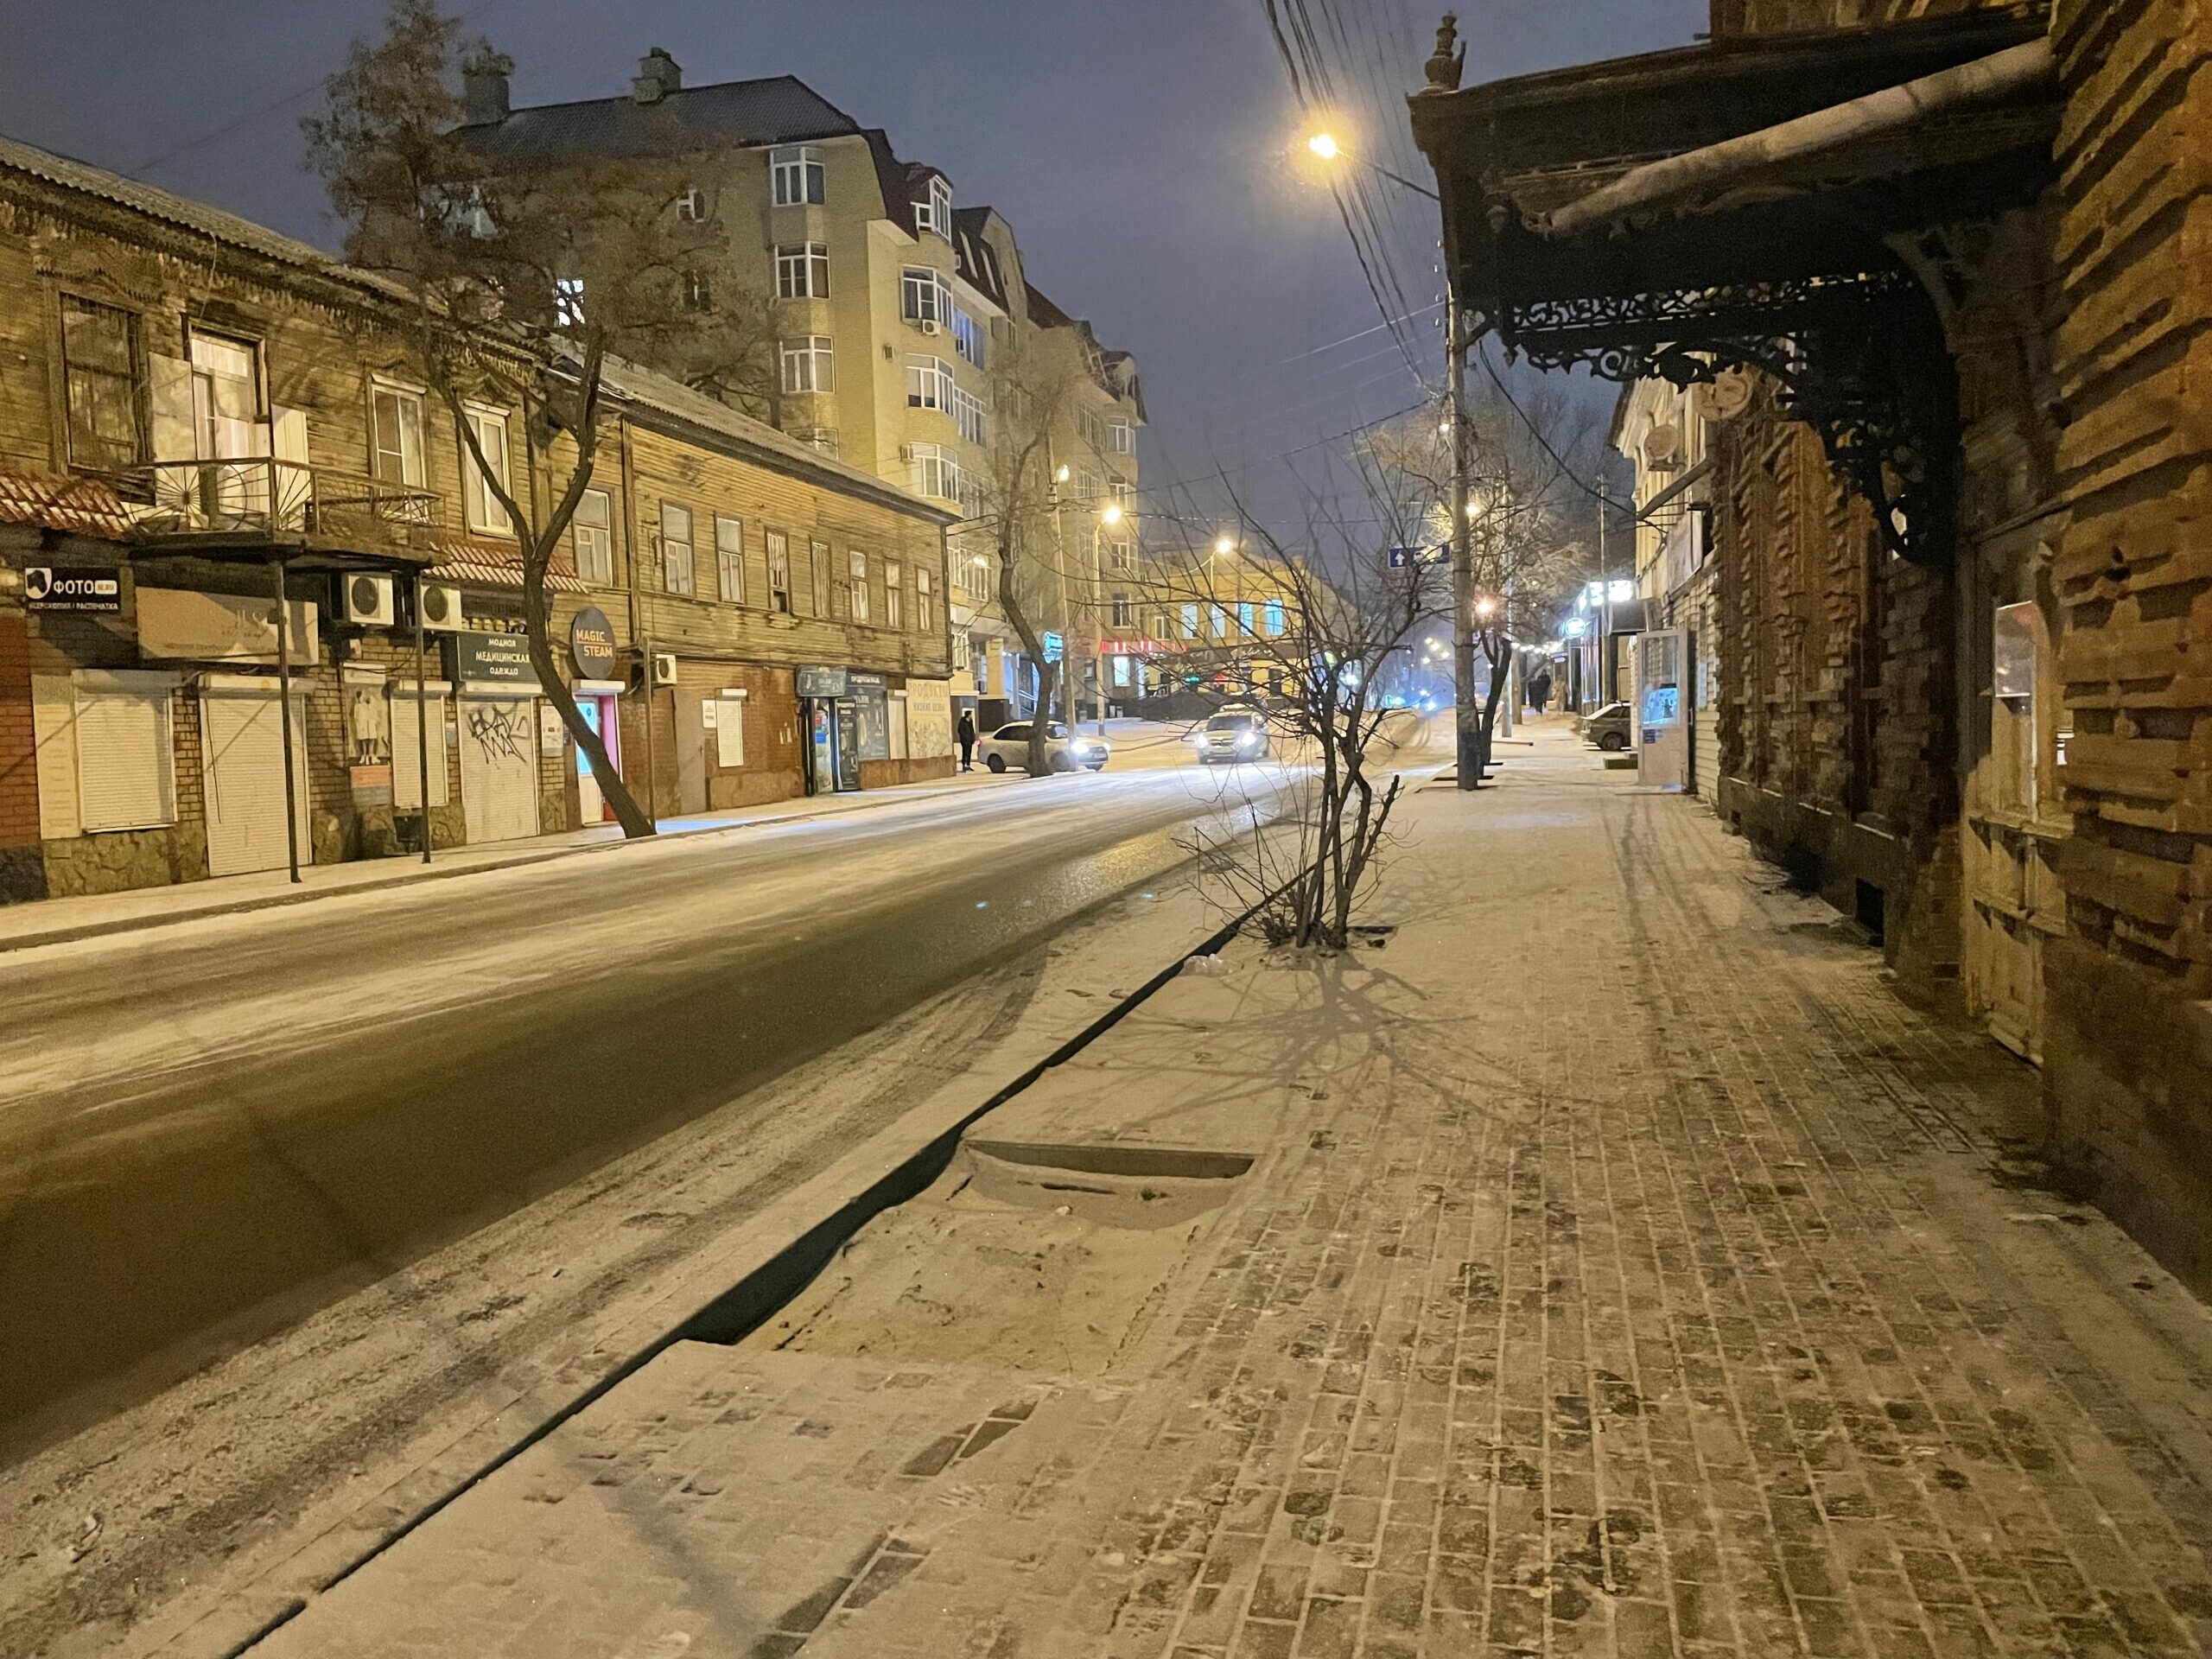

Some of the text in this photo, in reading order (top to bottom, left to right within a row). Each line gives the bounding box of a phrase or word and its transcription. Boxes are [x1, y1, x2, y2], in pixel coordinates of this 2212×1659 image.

[54, 580, 94, 594] ФОТО
[576, 629, 606, 642] MAGIC
[475, 652, 531, 664] МЕДИЦИНСКАЯ
[583, 645, 613, 658] STEAM
